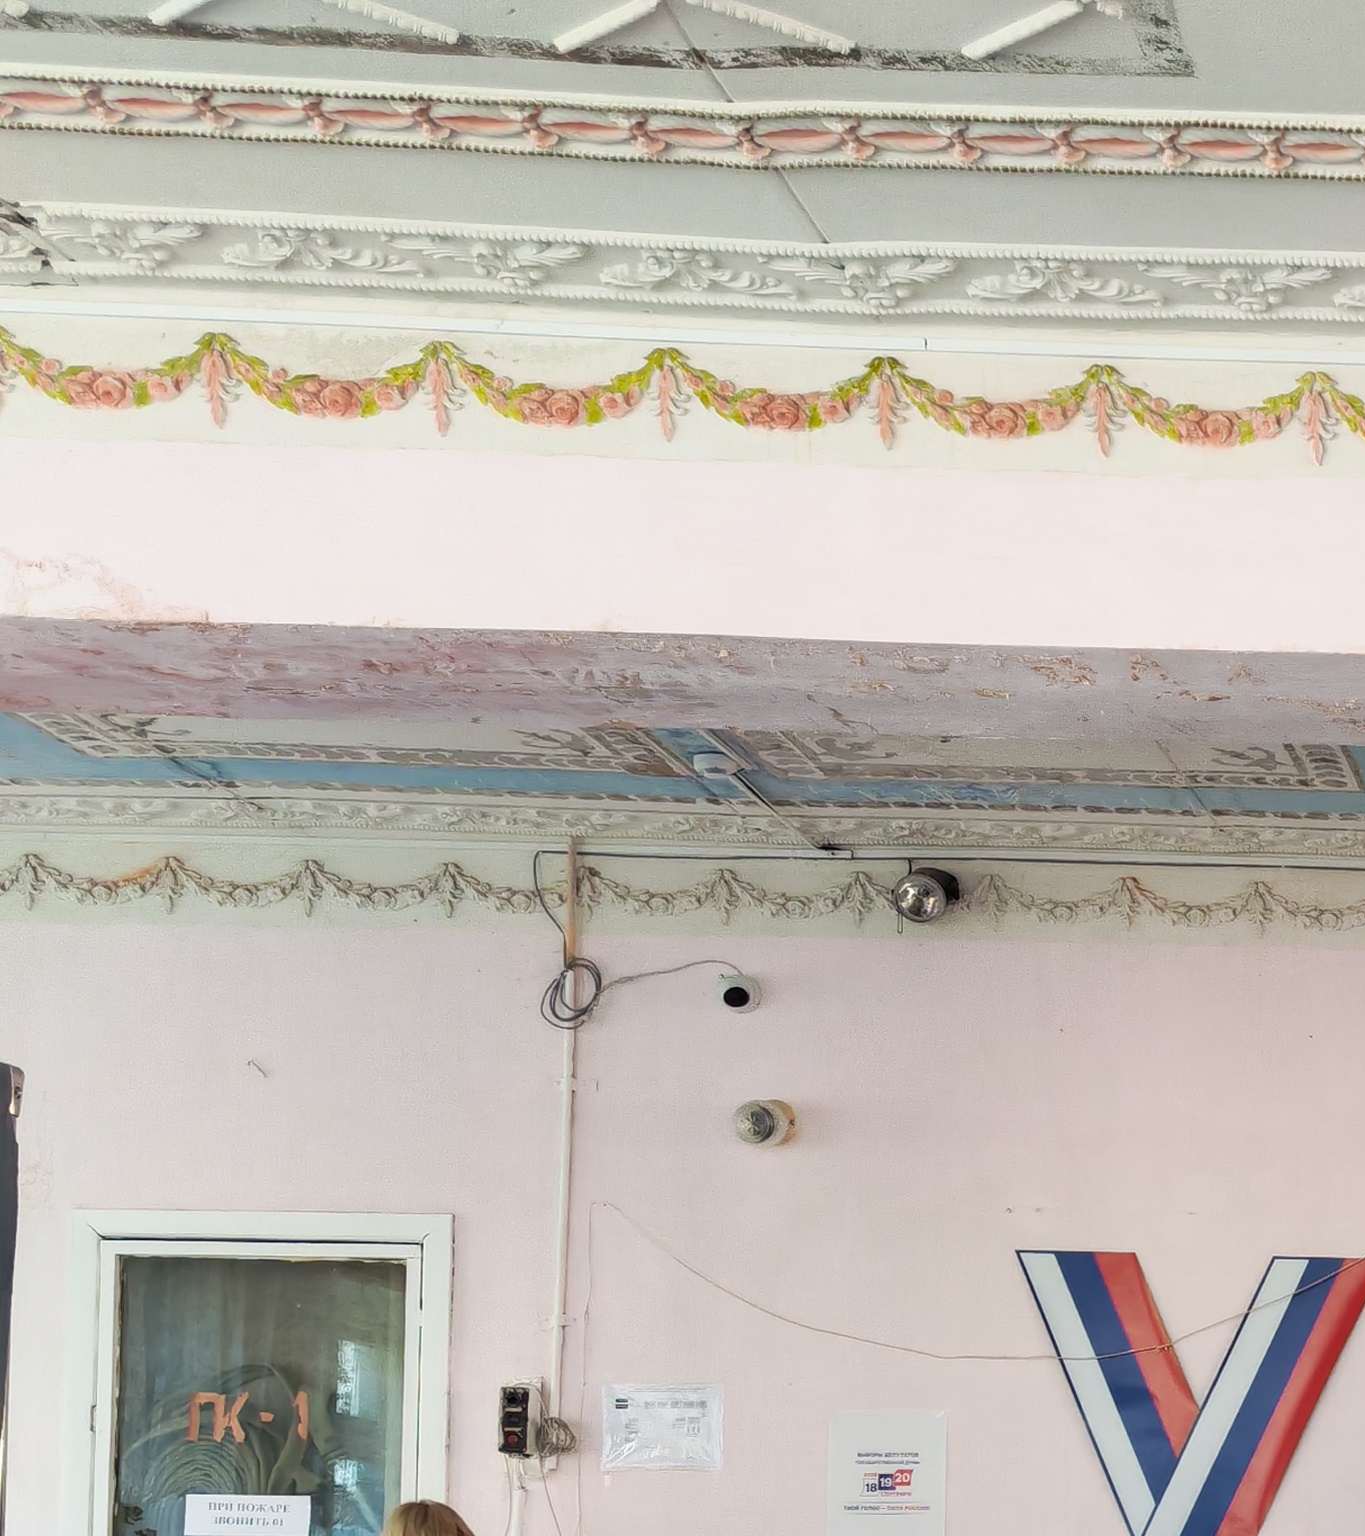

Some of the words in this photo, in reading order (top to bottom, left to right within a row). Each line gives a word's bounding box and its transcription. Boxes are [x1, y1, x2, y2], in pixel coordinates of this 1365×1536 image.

[865, 1482, 878, 1492] 18
[880, 1477, 893, 1487] 19
[895, 1472, 911, 1483] 20
[208, 1502, 233, 1511] ПРИ
[236, 1502, 291, 1513] ПОЖАРЕ
[212, 1516, 270, 1527] ЗВОНИТЬ
[272, 1517, 284, 1527] 01
